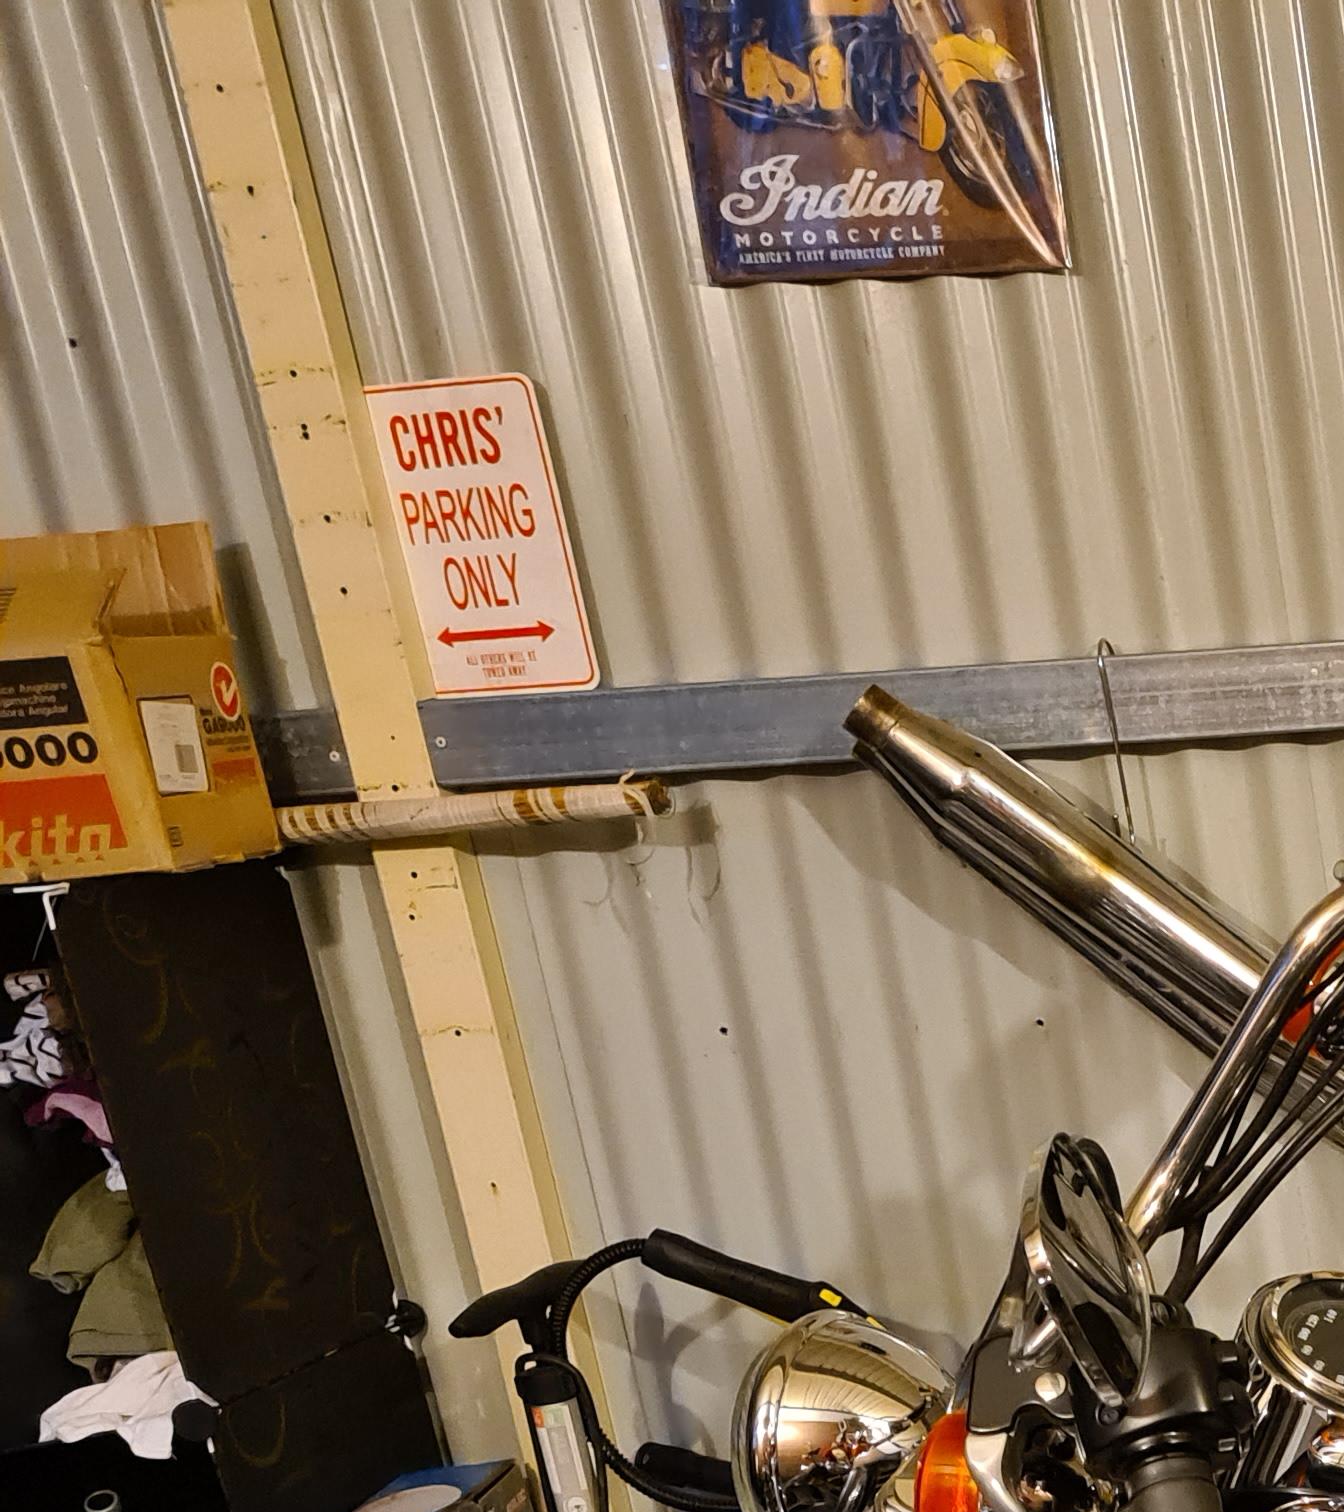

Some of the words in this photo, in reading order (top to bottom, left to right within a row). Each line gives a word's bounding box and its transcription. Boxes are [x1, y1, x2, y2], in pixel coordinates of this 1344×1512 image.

[719, 154, 945, 226] Indian
[734, 225, 943, 248] MOTORCYCLE
[738, 251, 791, 264] AMERICA'S
[830, 247, 895, 261] MOTORCYCLE
[899, 245, 945, 258] COMPANY
[390, 406, 503, 472] CHRIS'
[400, 483, 536, 546] PARKING
[443, 552, 520, 610] ONLY
[0, 732, 98, 770] 000
